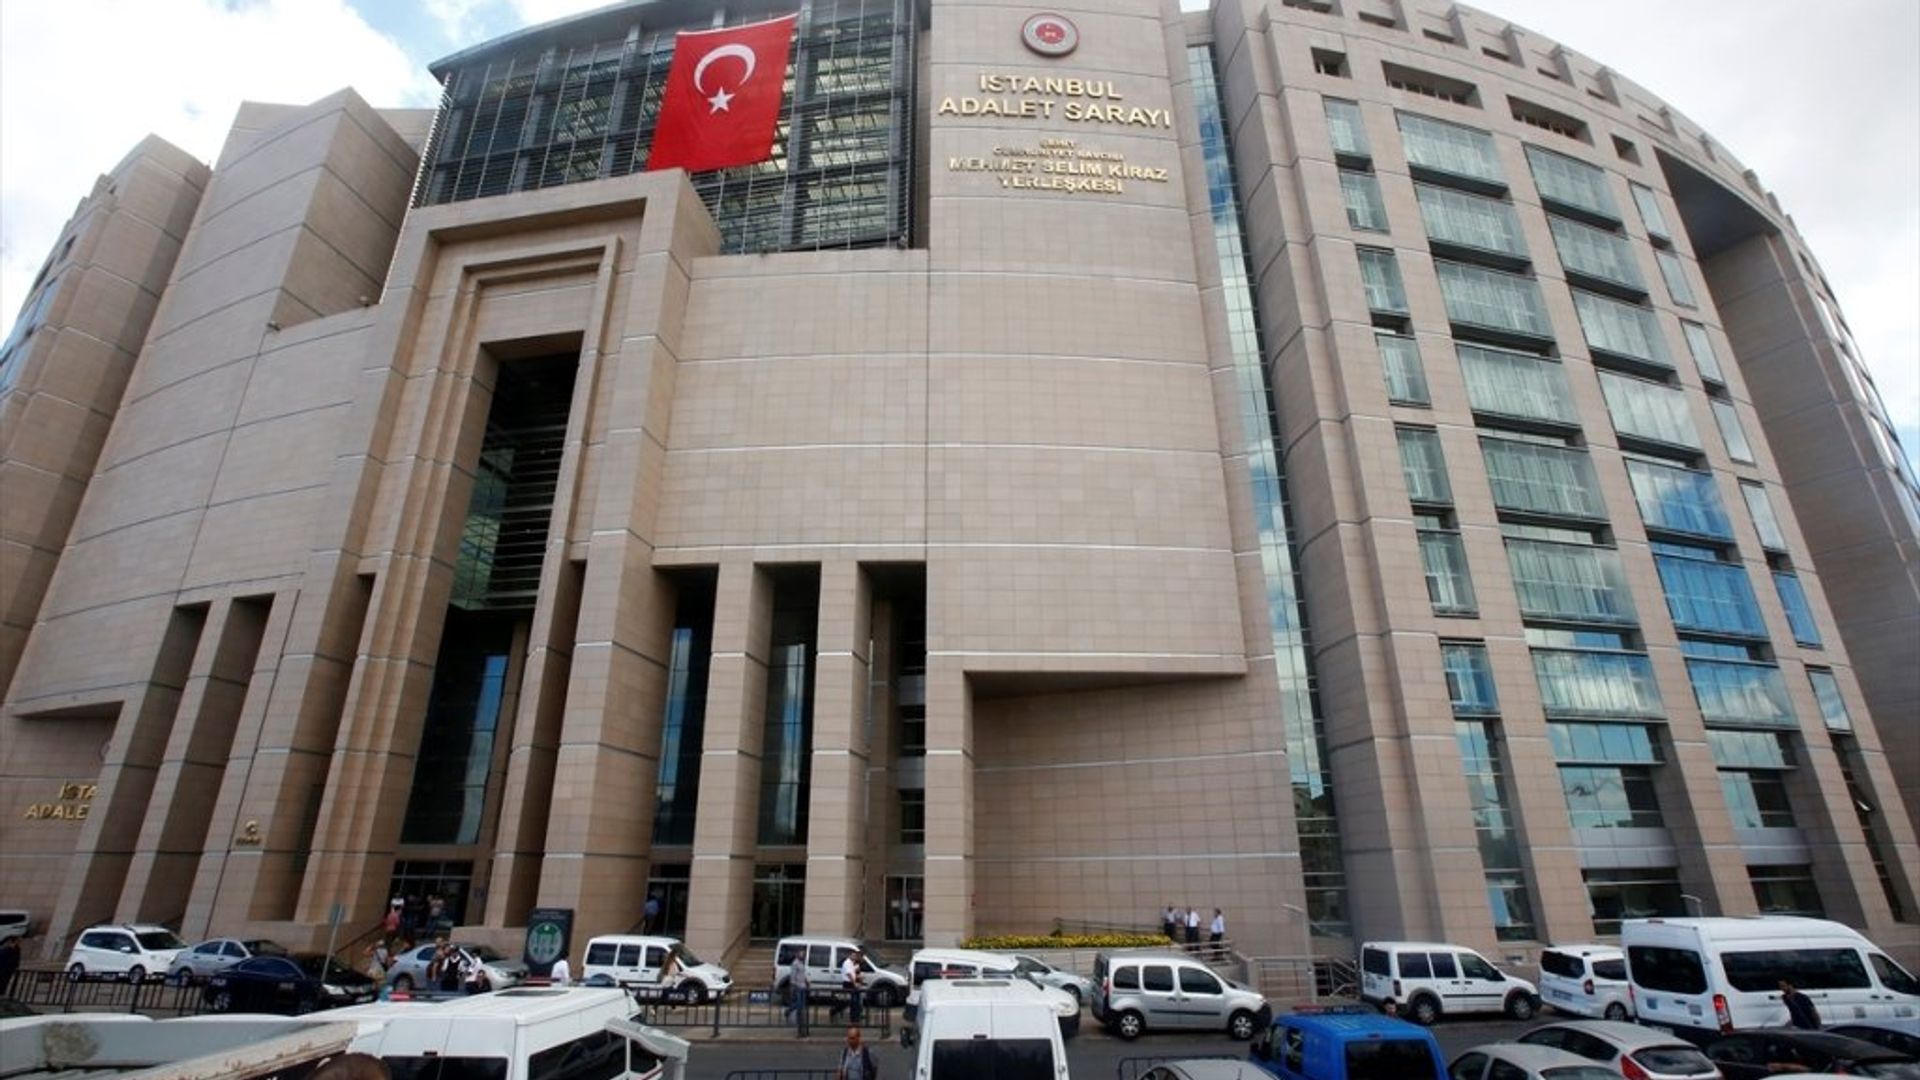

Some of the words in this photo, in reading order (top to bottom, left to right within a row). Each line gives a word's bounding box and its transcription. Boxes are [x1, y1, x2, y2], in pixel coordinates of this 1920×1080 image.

[938, 97, 1055, 119] ADALET
[1064, 102, 1171, 128] SARAYI
[949, 157, 1036, 173] MEHMET
